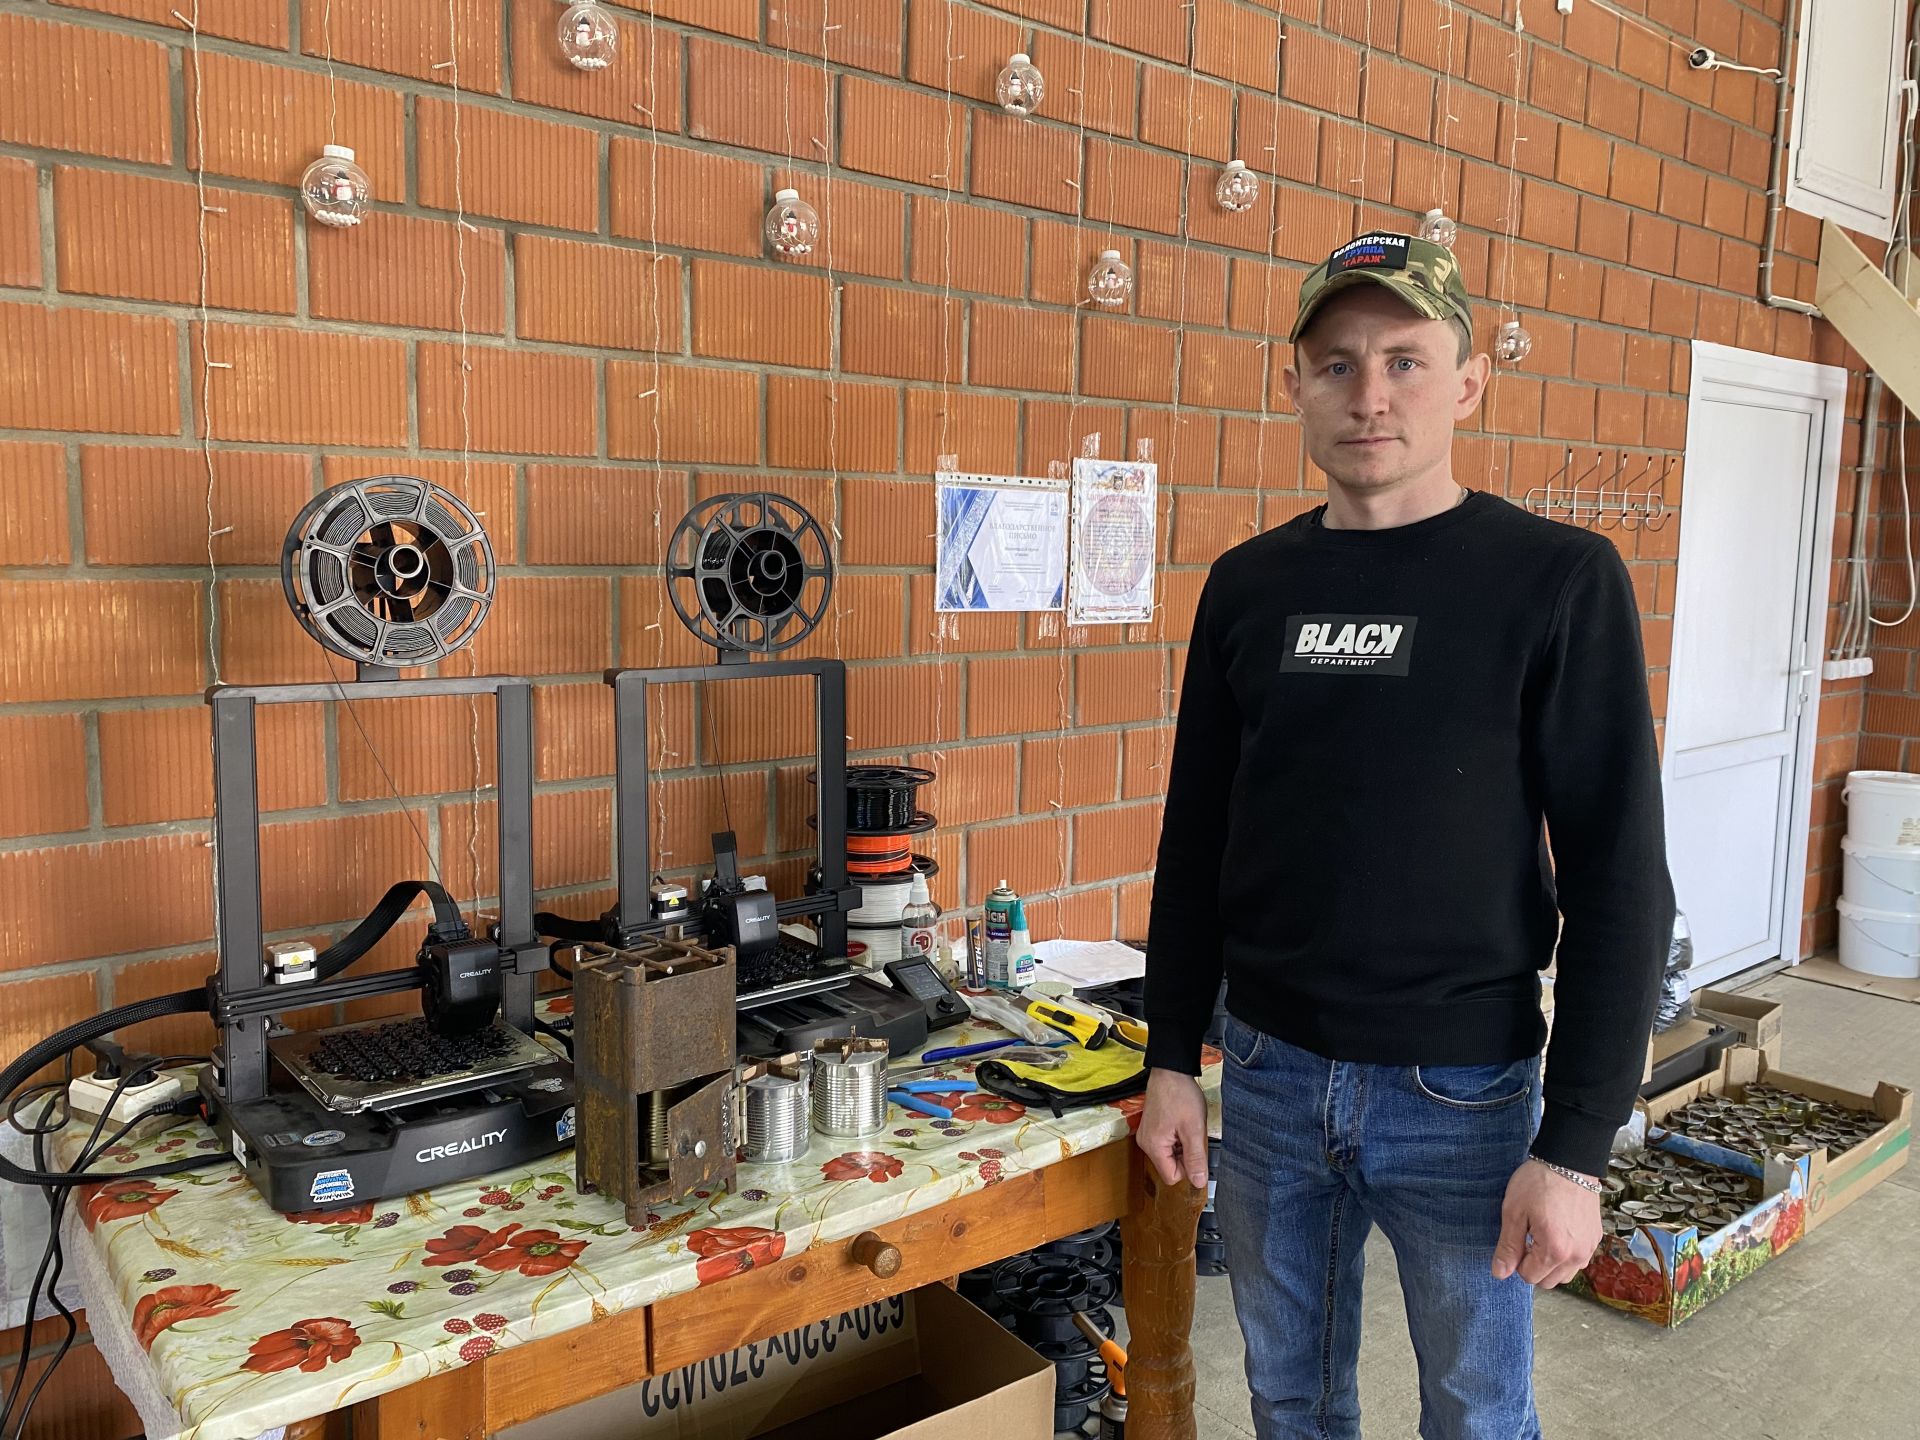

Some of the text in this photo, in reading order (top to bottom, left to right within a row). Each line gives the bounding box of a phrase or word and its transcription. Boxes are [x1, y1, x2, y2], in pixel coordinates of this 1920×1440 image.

[1333, 236, 1406, 259] ВОЛОНТЕРСКАЯ
[1344, 245, 1385, 259] ГРУППА
[1294, 623, 1404, 655] BLACK
[1310, 657, 1377, 666] DEPARTMENT
[744, 914, 771, 924] CREALITY
[459, 968, 492, 979] CREALITY
[416, 1128, 508, 1164] CREALITY
